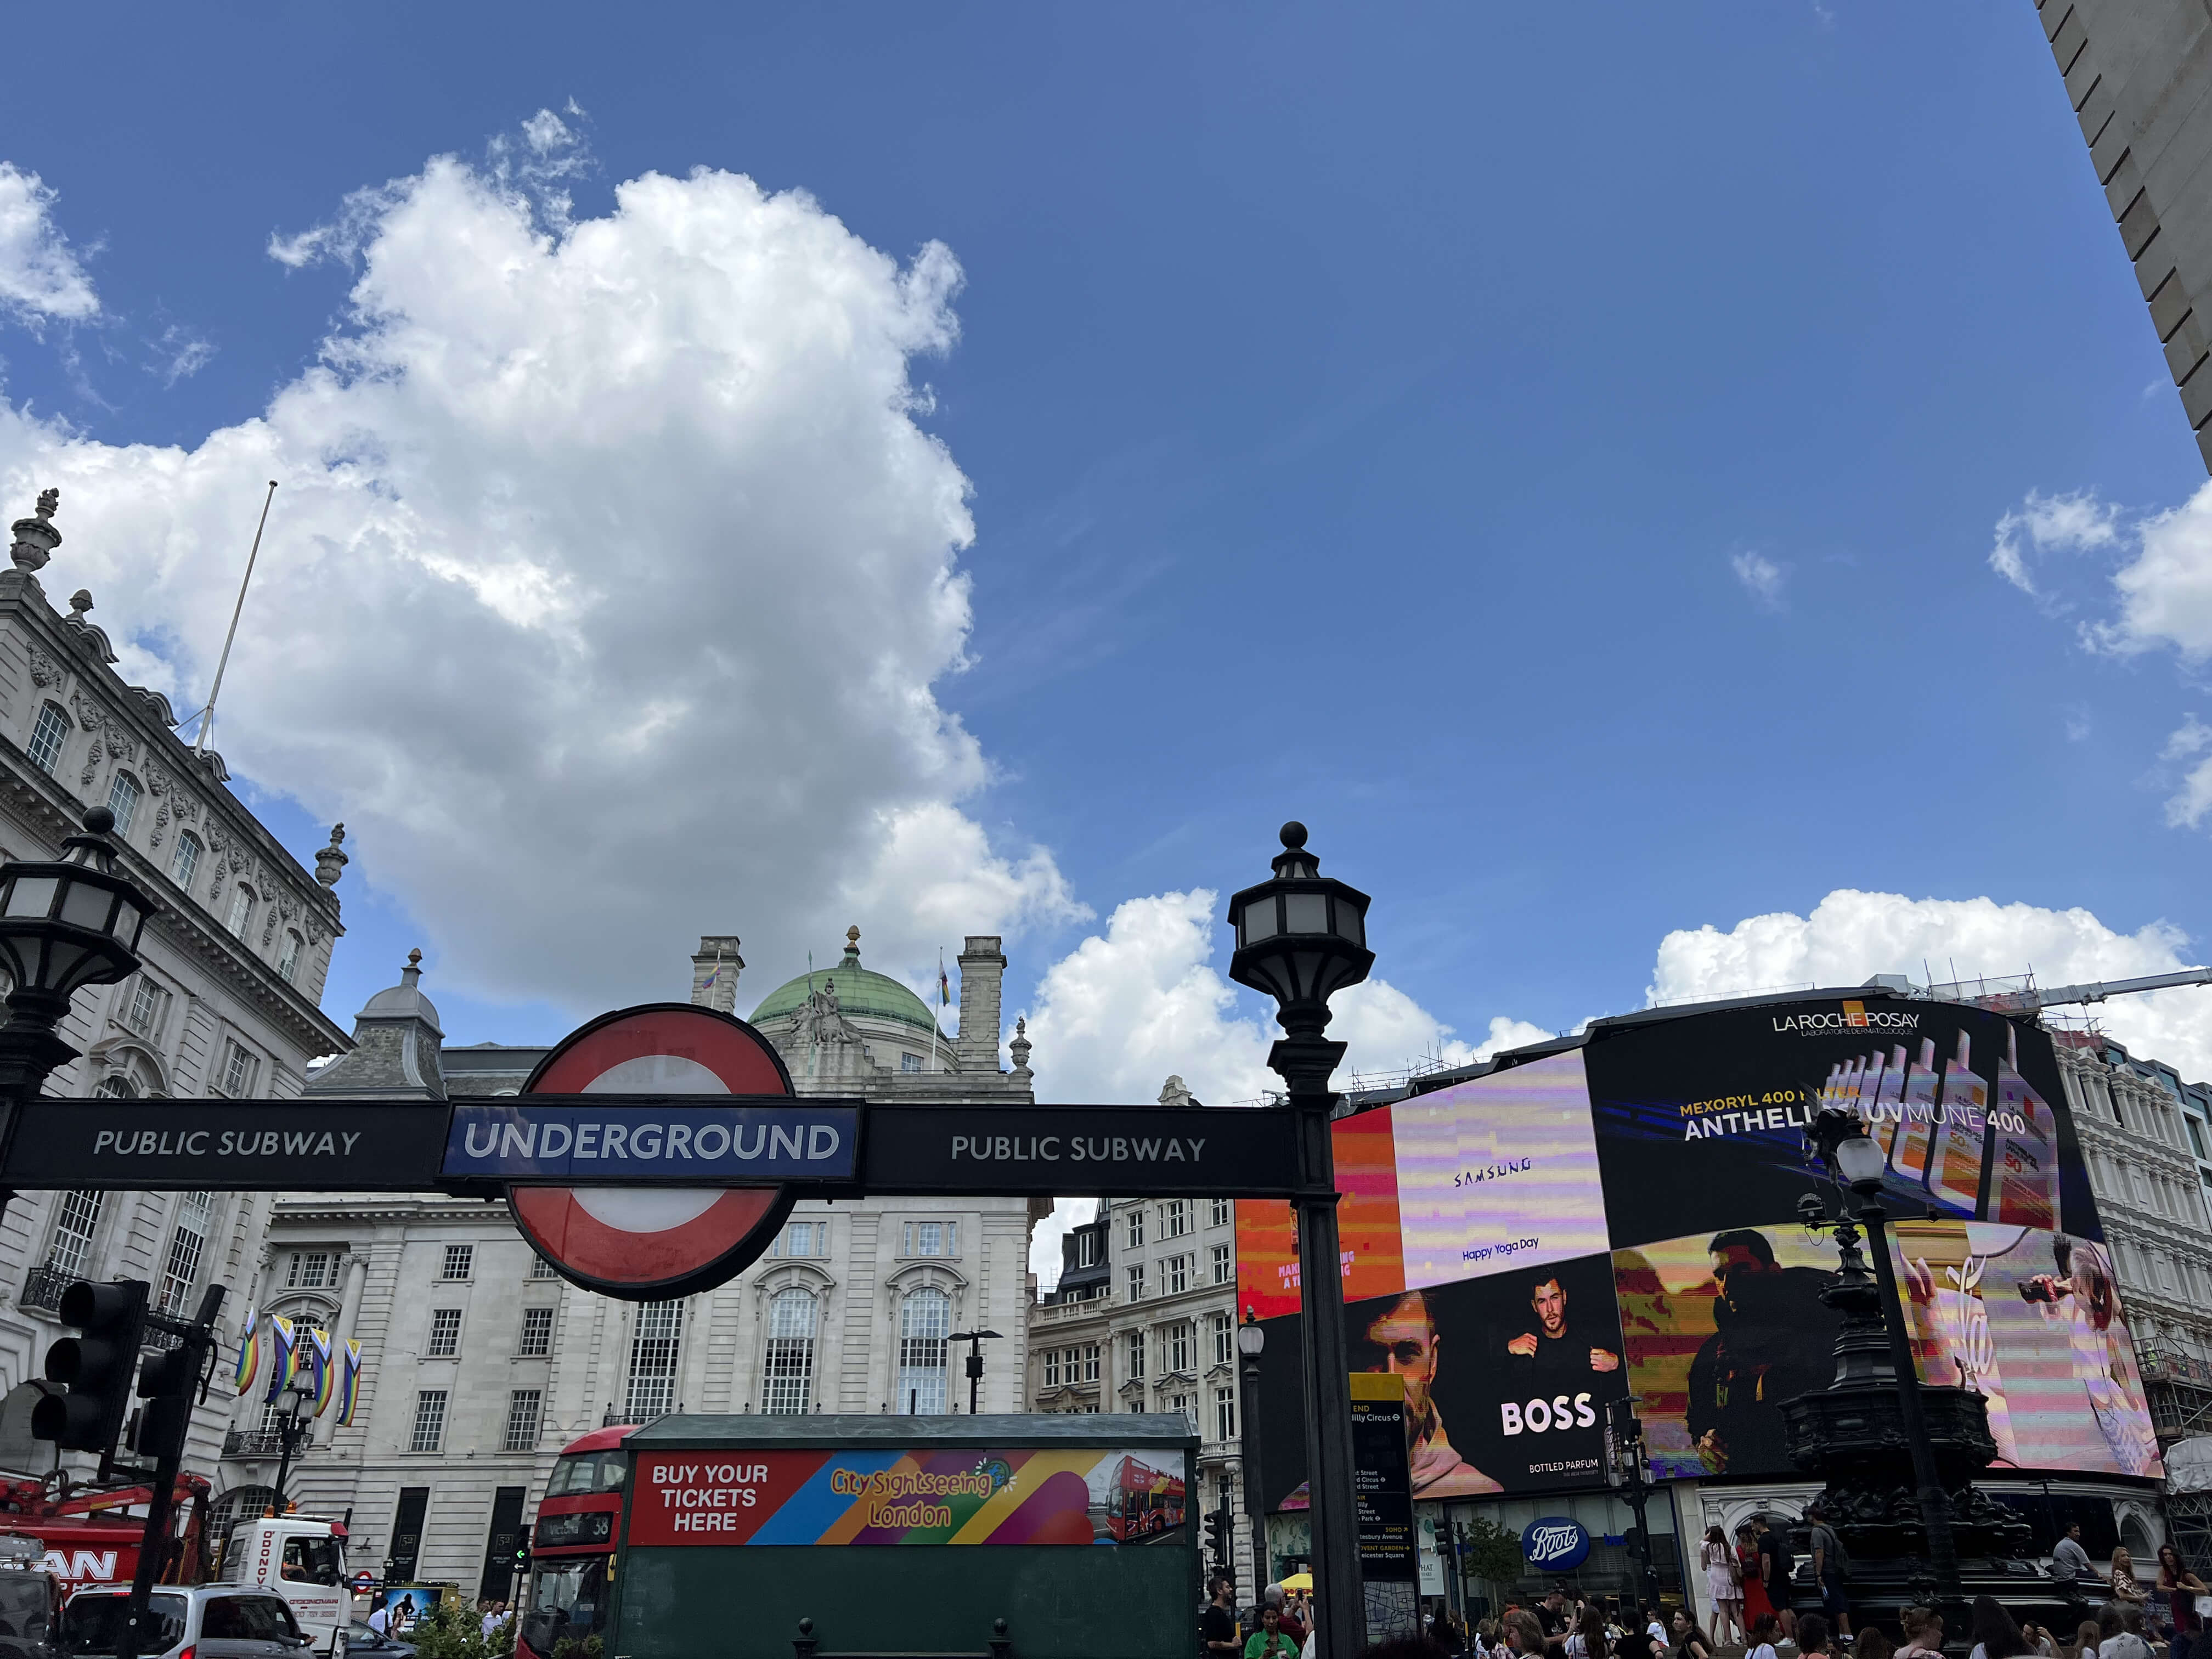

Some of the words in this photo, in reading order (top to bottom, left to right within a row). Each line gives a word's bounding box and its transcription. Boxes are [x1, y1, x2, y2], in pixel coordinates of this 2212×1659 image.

[1773, 1016, 1798, 1031] LA
[1680, 1094, 1758, 1116] MEXORYL
[1762, 1090, 1796, 1104] 400
[1685, 1103, 1852, 1141] ANTHELI
[1987, 1110, 2026, 1135] 400
[93, 1131, 210, 1155] PUBLIC
[217, 1131, 361, 1156] SUBWAY
[464, 1123, 839, 1159] UNDERGROUND
[951, 1136, 1060, 1160] PUBLIC
[1070, 1137, 1206, 1161] SUBWAY
[1454, 1157, 1531, 1188] SAMSUNG
[1340, 1250, 1355, 1264] ING
[1463, 1247, 1493, 1261] Happy
[1494, 1242, 1519, 1255] Yoga
[1520, 1237, 1539, 1250] Day
[1283, 1277, 1291, 1289] A
[1352, 1414, 1365, 1423] illy
[1500, 1392, 1596, 1436] BOSS
[652, 1465, 699, 1483] BUY
[704, 1464, 769, 1483] YOUR
[1529, 1462, 1564, 1474] BOTTLED
[1565, 1459, 1599, 1470] PARFUM
[831, 1468, 871, 1497] City
[873, 1471, 991, 1499] Sightseeing
[660, 1488, 757, 1508] TICKETS
[674, 1513, 738, 1531] HERE
[867, 1500, 951, 1528] London
[1529, 1524, 1579, 1561] Boots
[30, 1550, 117, 1580] AN
[257, 1531, 275, 1585] O'DONOV
